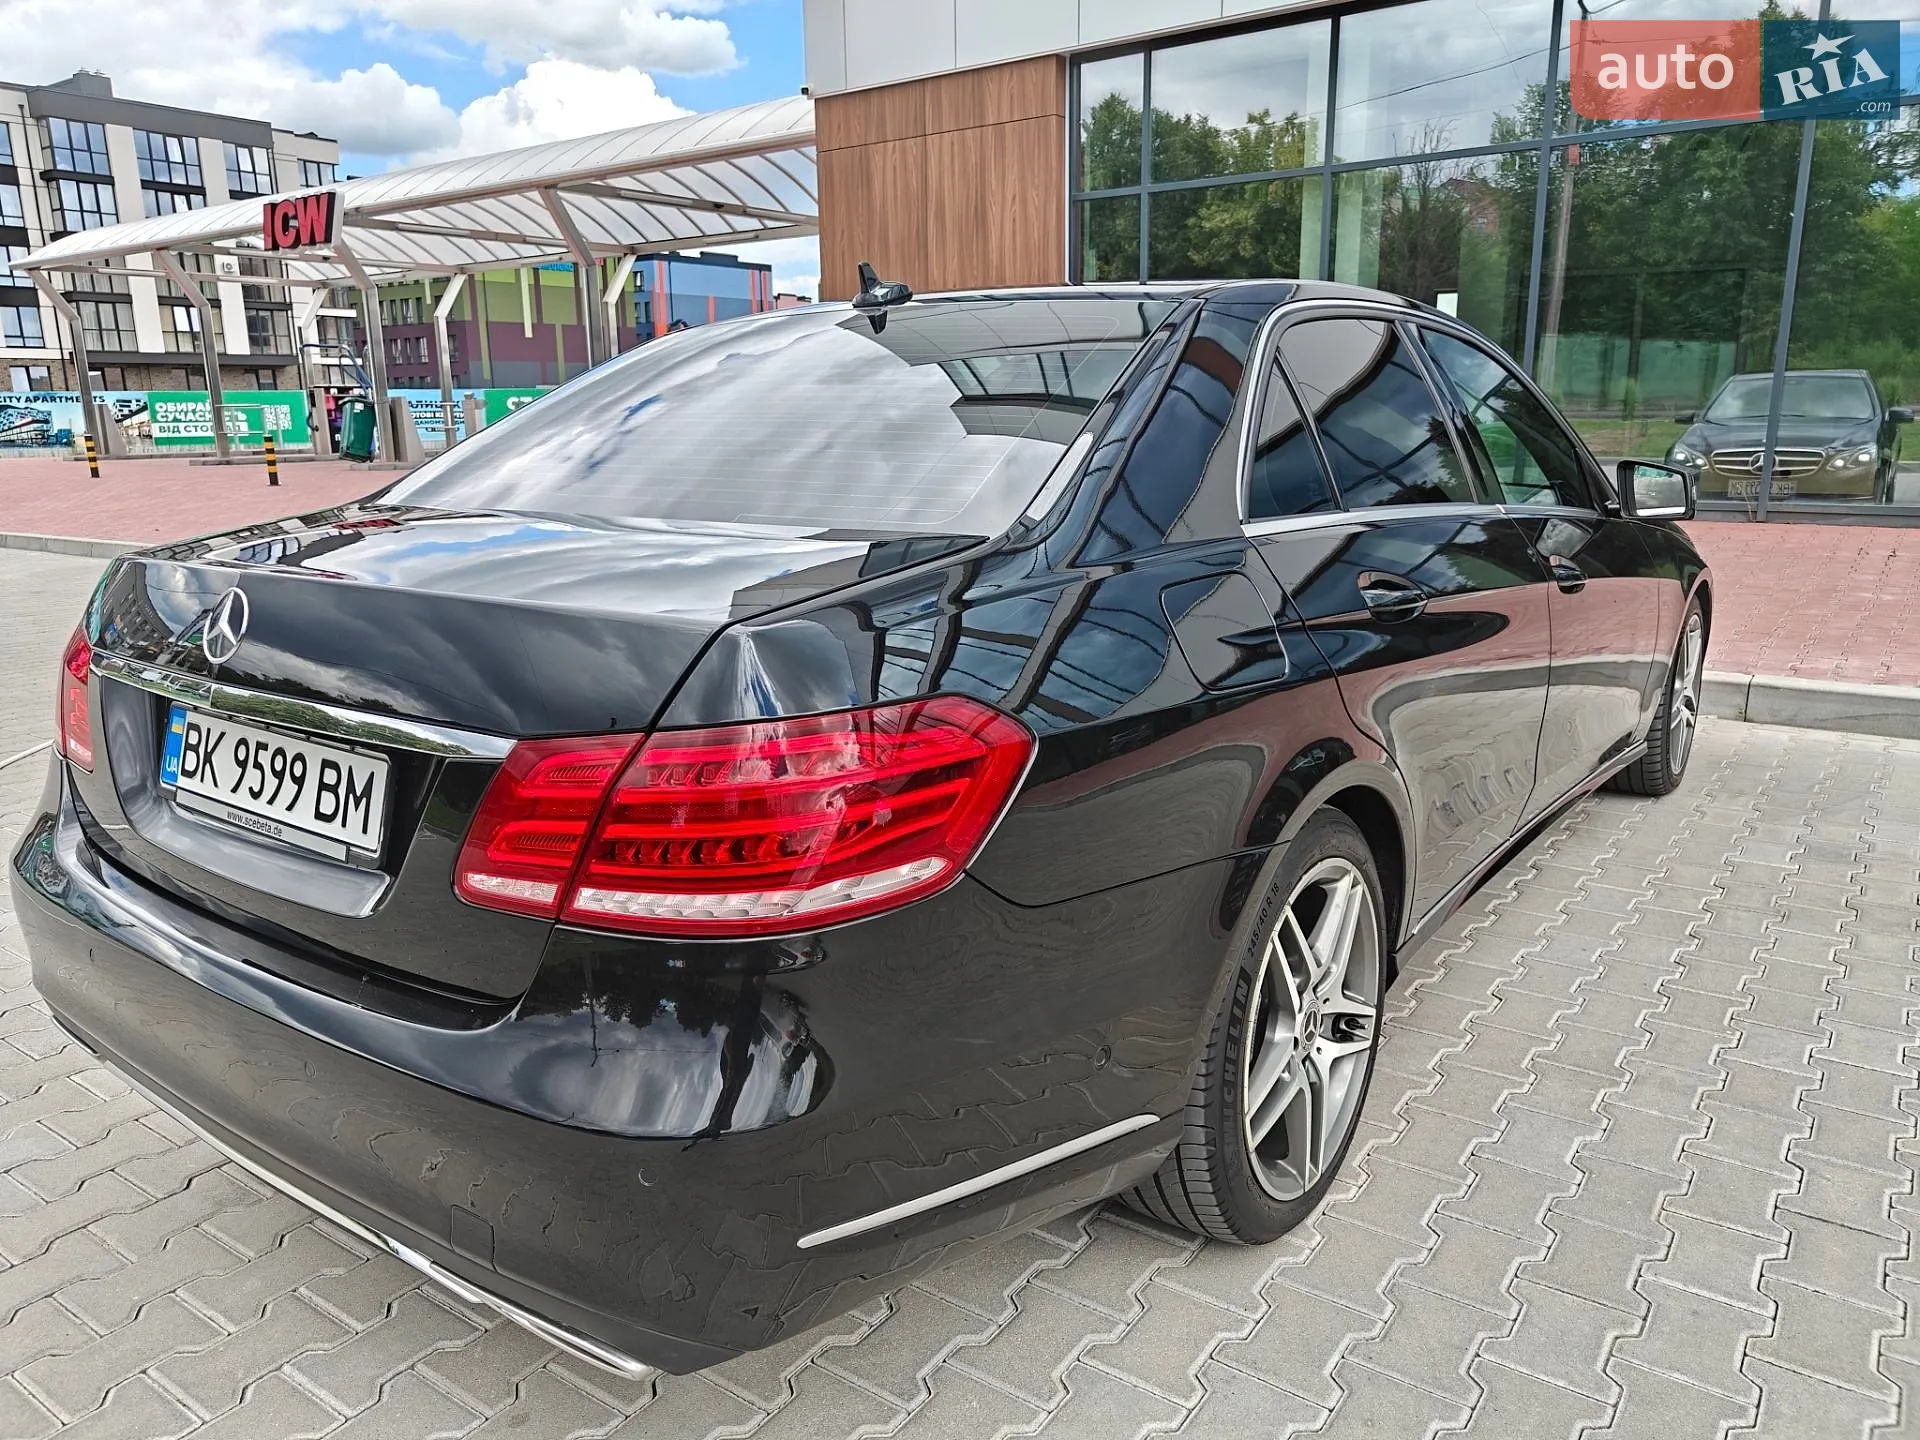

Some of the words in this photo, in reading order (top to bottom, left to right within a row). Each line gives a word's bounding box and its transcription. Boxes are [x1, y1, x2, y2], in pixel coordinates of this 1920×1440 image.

[263, 192, 334, 251] ICW
[0, 395, 22, 404] ITY
[24, 395, 106, 404] APARTMETS
[165, 755, 178, 773] UA
[180, 721, 226, 788] BK
[230, 736, 307, 812] 9599
[314, 758, 375, 835] BM
